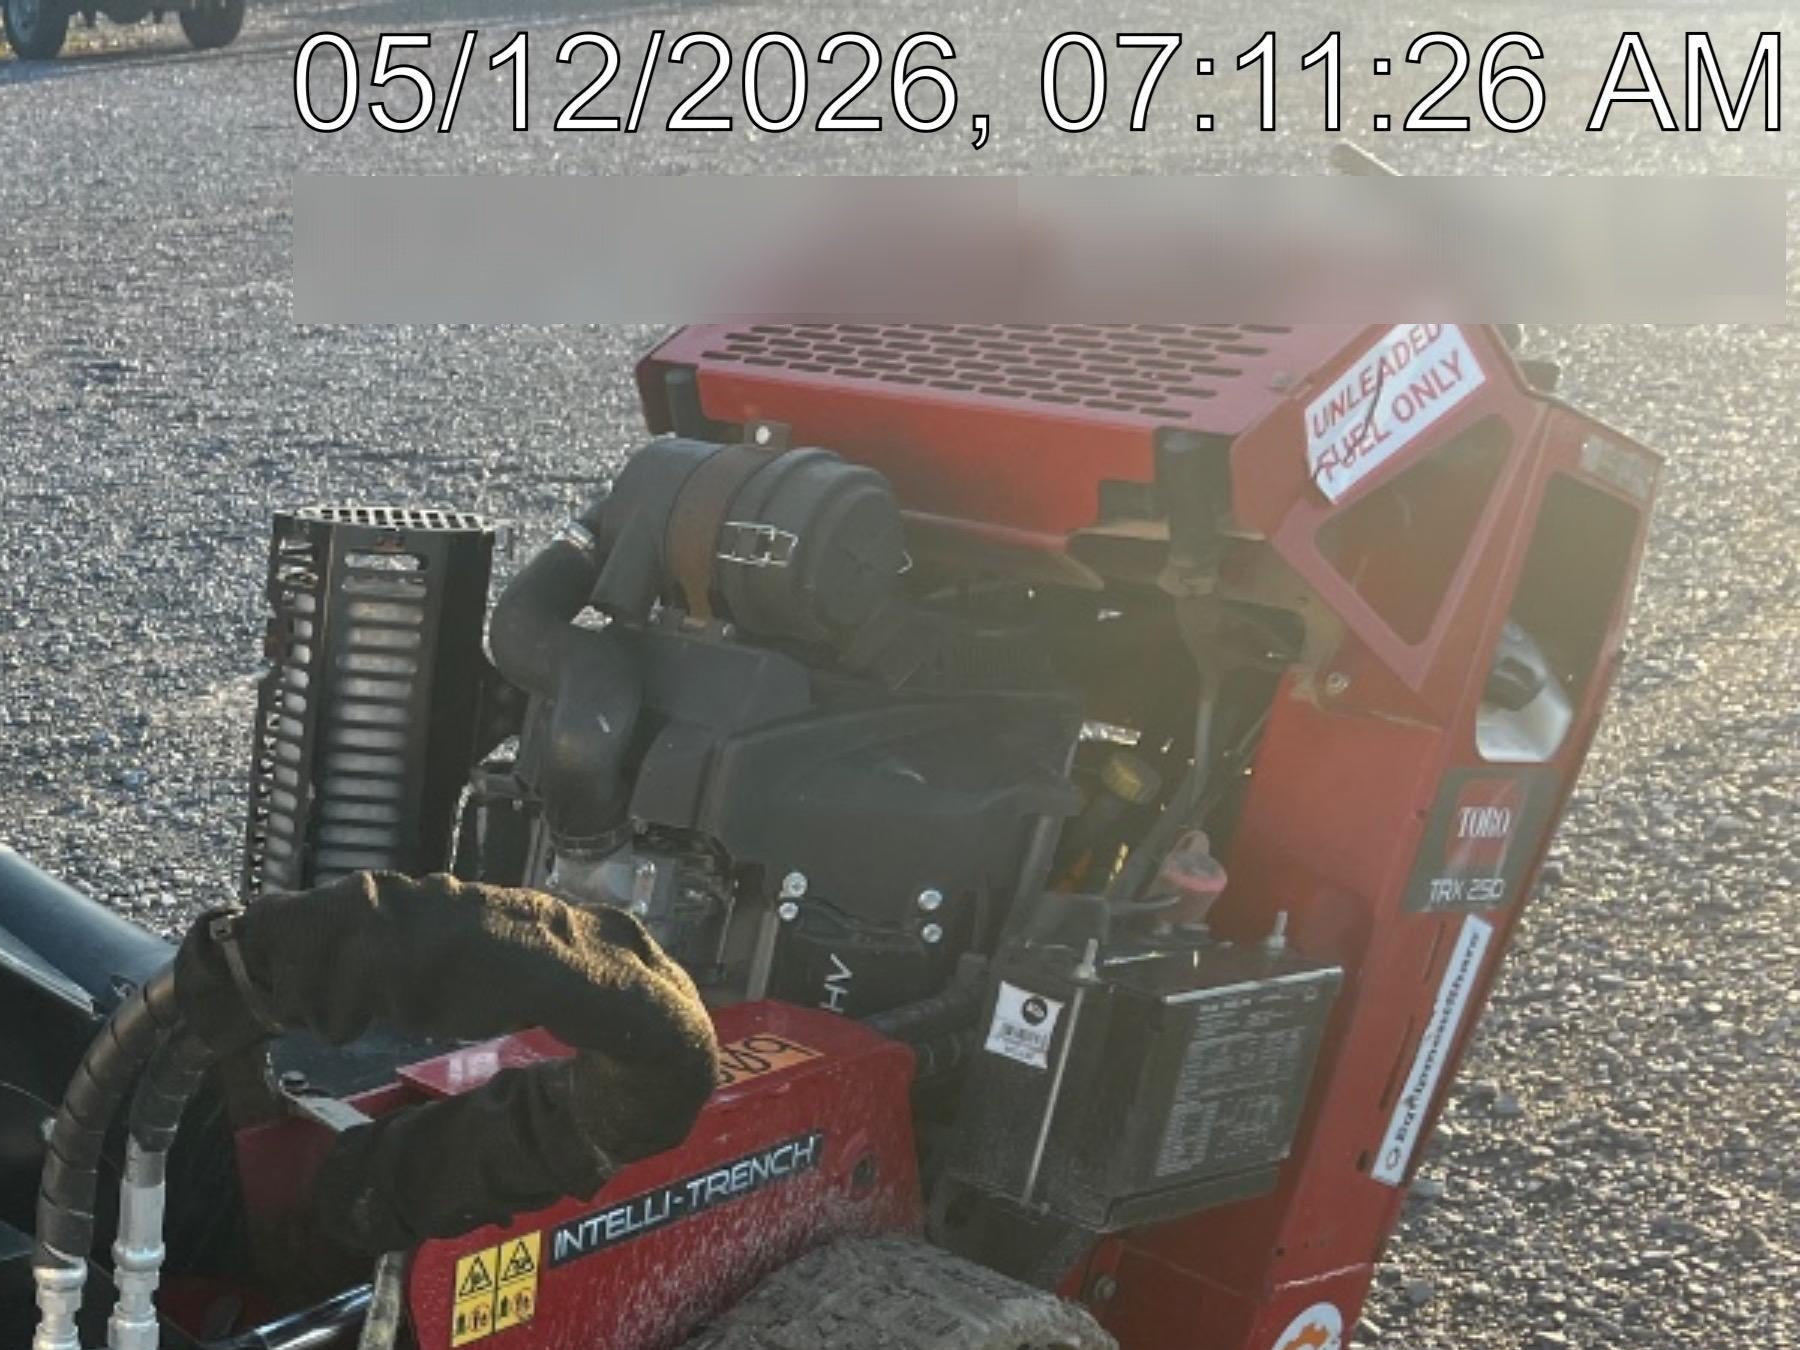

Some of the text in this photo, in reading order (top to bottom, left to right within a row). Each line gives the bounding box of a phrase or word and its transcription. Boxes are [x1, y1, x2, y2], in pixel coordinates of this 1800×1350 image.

[1313, 324, 1441, 438] UNLEADED
[1315, 350, 1462, 482] FUEL ONLY
[1458, 807, 1510, 838] TORO
[555, 1135, 816, 1261] INTELLI-TRENCH
